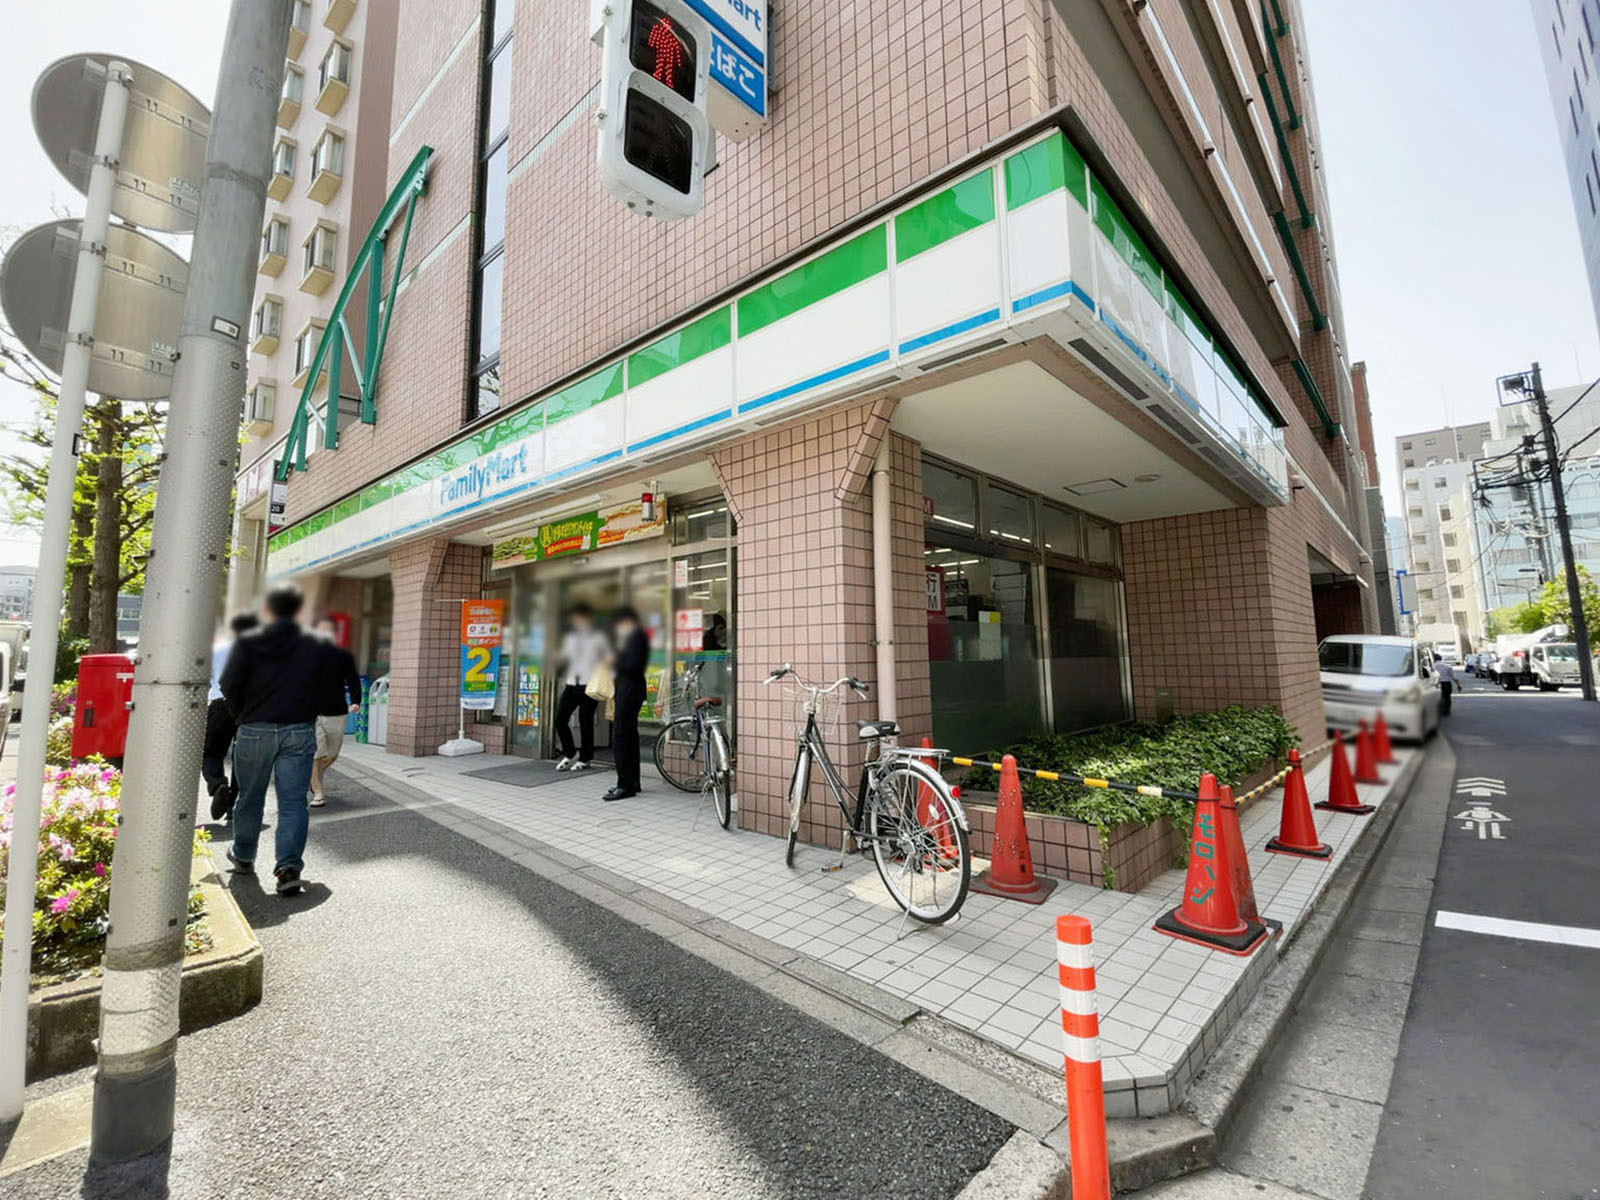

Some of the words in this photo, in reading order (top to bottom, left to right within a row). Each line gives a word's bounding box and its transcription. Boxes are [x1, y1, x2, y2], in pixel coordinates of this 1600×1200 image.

[710, 44, 757, 98] ばこ
[440, 443, 527, 504] FamilyMart
[465, 647, 492, 682] 2
